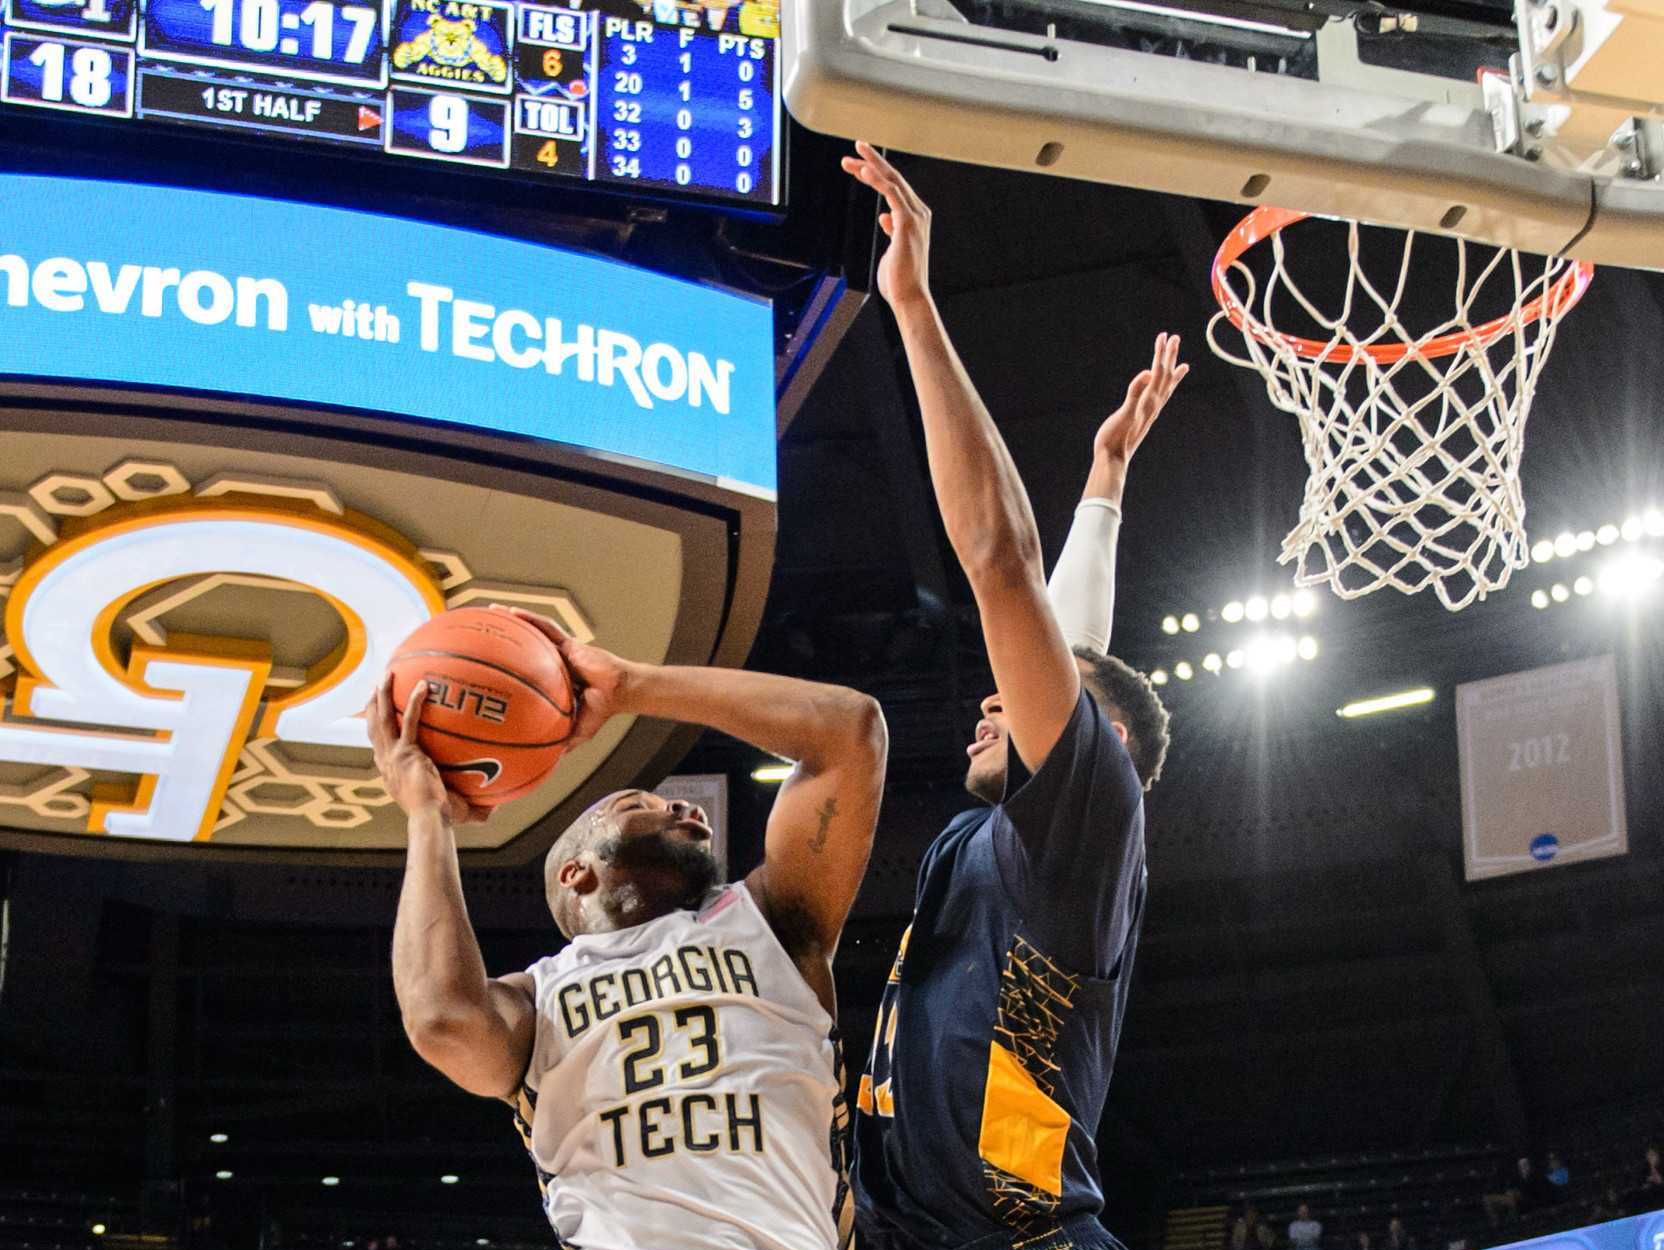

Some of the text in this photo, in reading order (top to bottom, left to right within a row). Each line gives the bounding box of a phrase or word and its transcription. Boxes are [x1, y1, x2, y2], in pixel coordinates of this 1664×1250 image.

[203, 0, 377, 64] 10:17
[528, 11, 576, 44] FLS
[605, 17, 765, 60] PLR F PTS
[28, 42, 112, 107] 18
[416, 63, 485, 83] AGGIES
[542, 49, 562, 77] 6
[621, 44, 753, 82] 3 1 0
[201, 86, 322, 122] 1ST HALF
[614, 71, 753, 110] 20 1 5
[428, 94, 469, 153] 9
[524, 101, 574, 135] TOL
[613, 100, 753, 138] 32 0 3
[537, 140, 558, 167] 4
[612, 128, 752, 167] 33 0 0
[611, 155, 752, 194] 34 0 0
[308, 299, 400, 343] with
[407, 282, 732, 414] TECHRON
[424, 679, 508, 724] ELITE
[1507, 733, 1570, 772] 2012
[558, 945, 760, 1039] GEORGIA
[617, 1004, 721, 1096] 23
[600, 1092, 764, 1169] TECH
